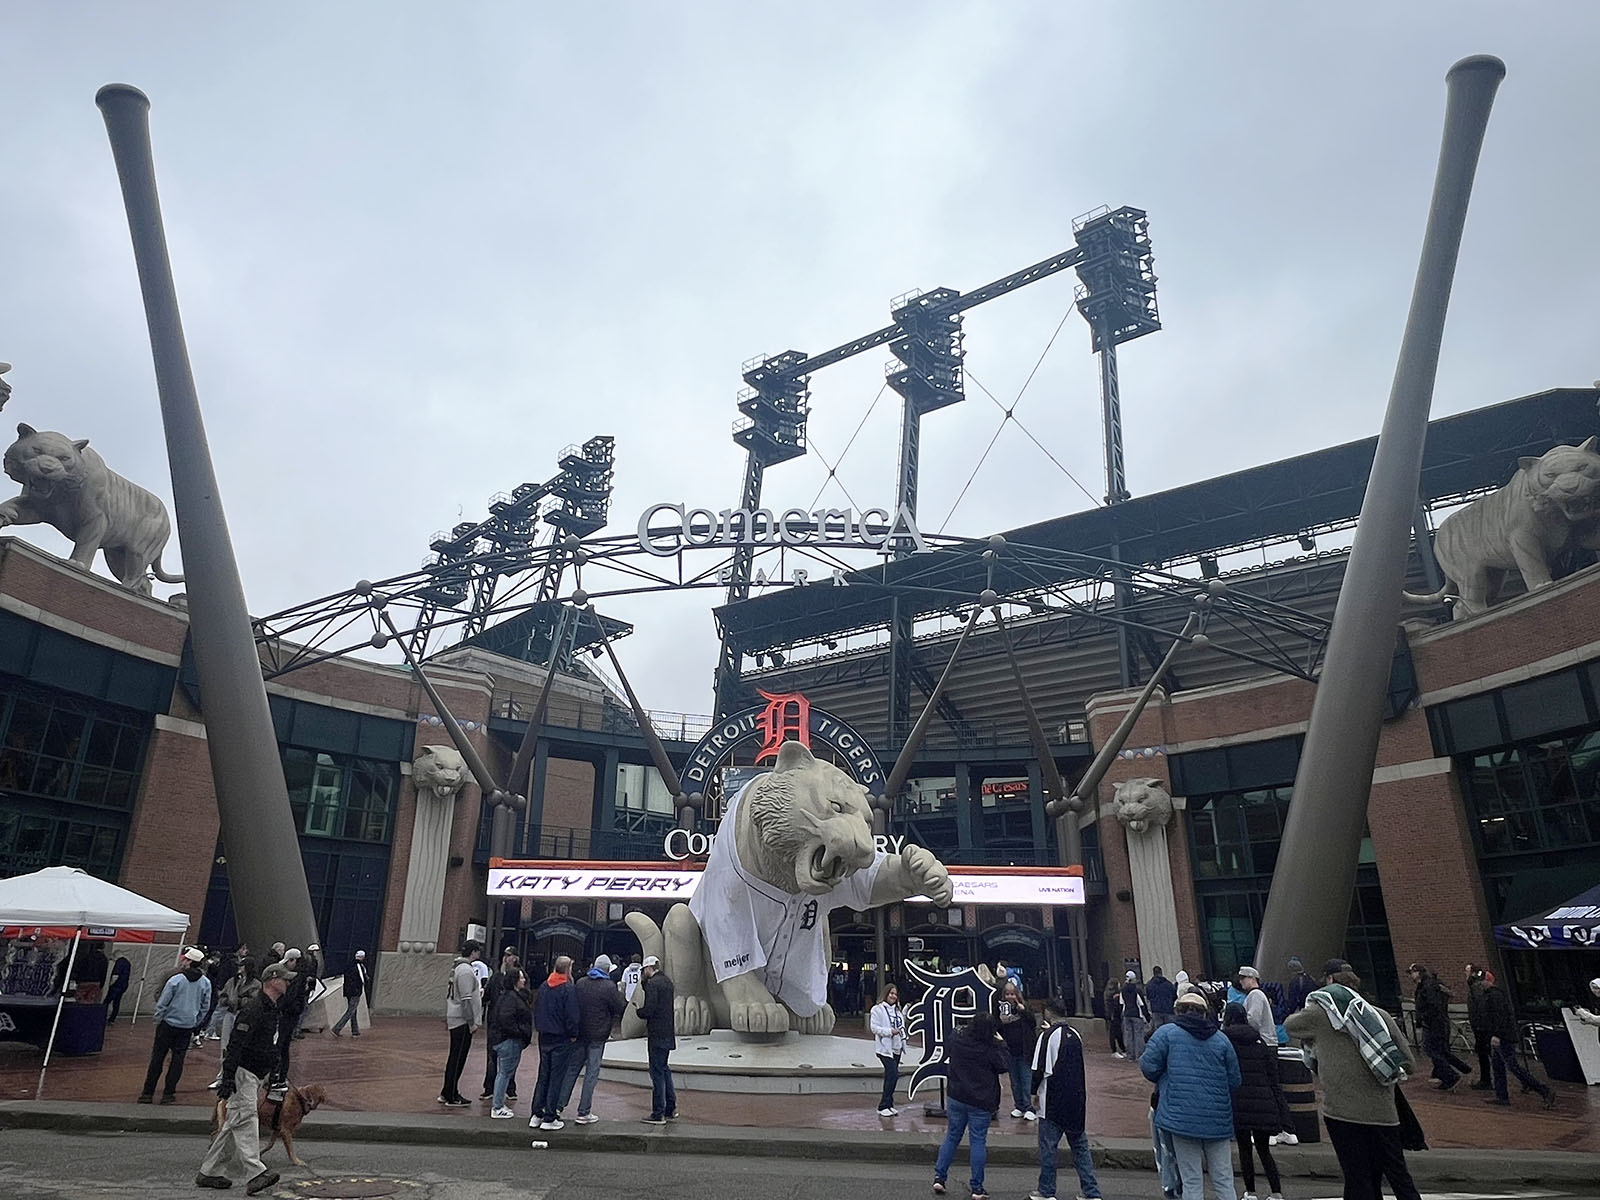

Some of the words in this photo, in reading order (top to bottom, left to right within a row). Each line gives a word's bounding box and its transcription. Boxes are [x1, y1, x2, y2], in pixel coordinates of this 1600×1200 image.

[716, 568, 849, 586] PARK
[687, 713, 758, 782] DETROIT
[818, 718, 880, 784] TIGERS
[872, 834, 905, 855] RY
[496, 875, 582, 890] KATY
[584, 876, 693, 891] PERRY
[724, 953, 750, 969] meijer
[628, 973, 639, 984] 19
